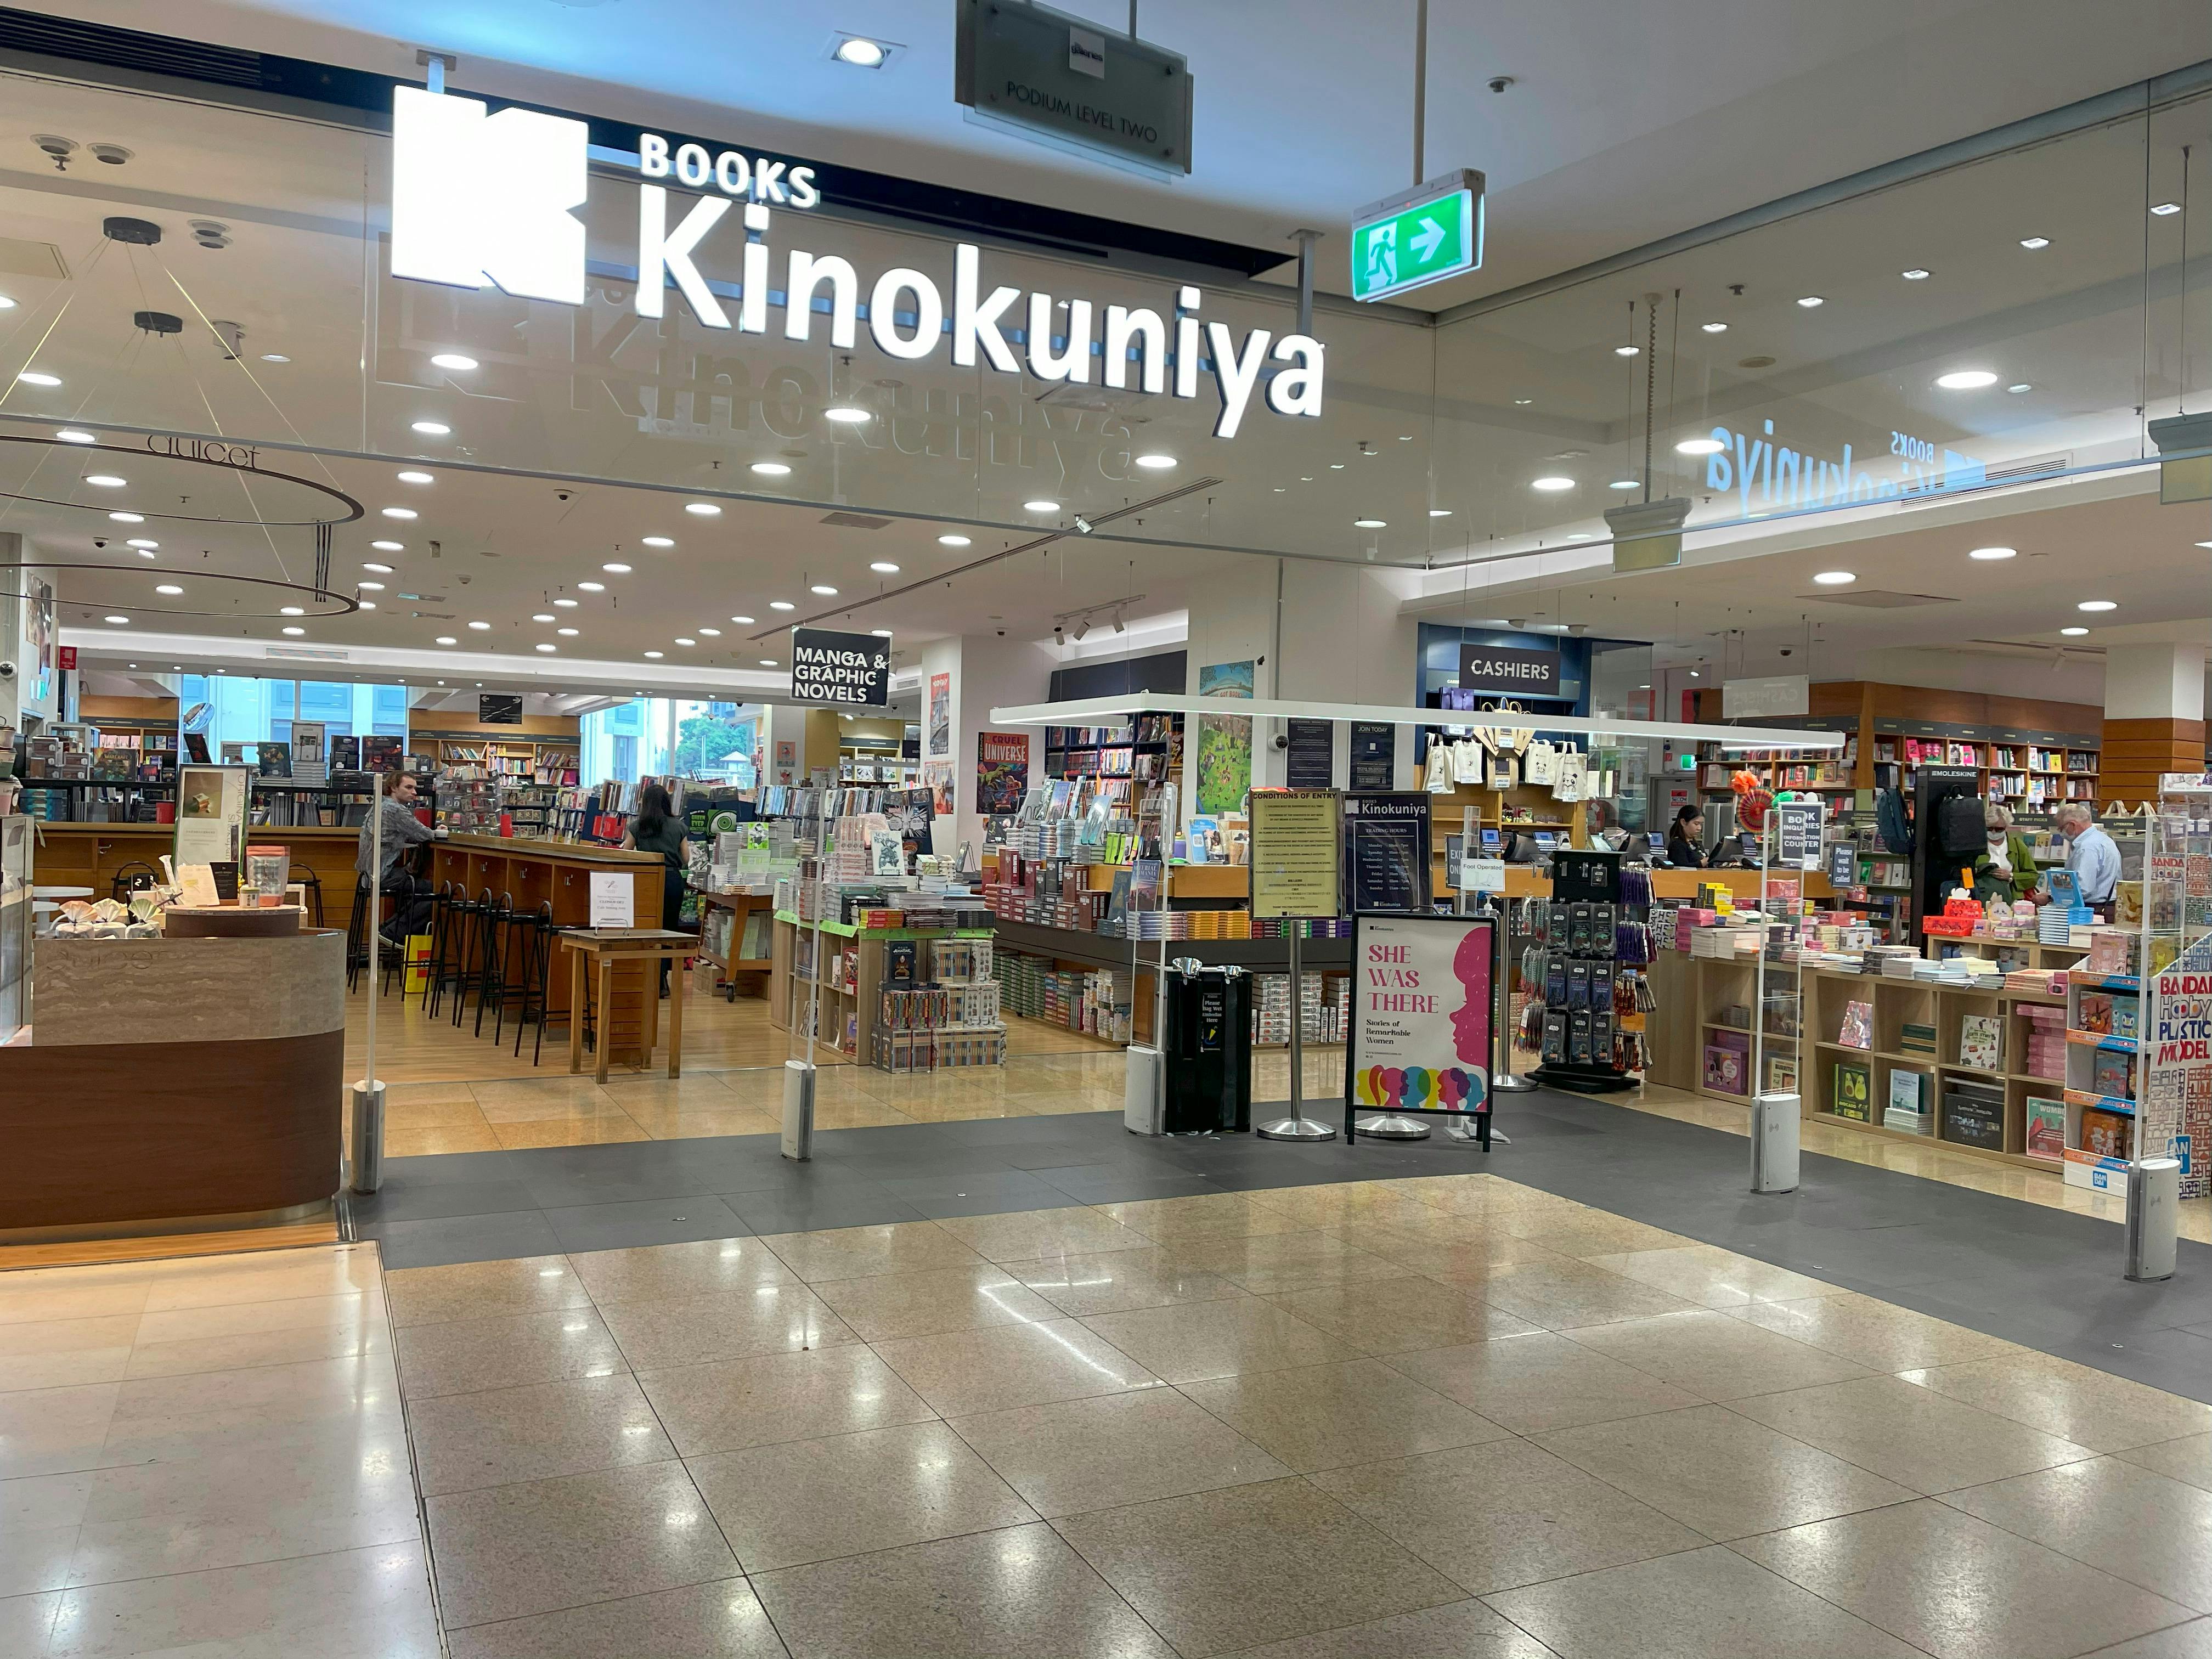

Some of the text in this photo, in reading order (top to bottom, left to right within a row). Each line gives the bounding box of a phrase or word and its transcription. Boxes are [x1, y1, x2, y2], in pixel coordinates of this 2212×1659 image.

[1007, 80, 1158, 143] PODIUM LEVEL TWO
[640, 132, 817, 210] BOOKS
[636, 184, 1327, 438] Kinokuniya
[795, 646, 887, 670] MANGA &
[794, 664, 877, 687] GRAPHIC
[1471, 659, 1550, 680] CASHIERS
[794, 681, 867, 703] NOVELS
[992, 736, 1022, 744] CRUEL
[985, 743, 1026, 761] UNIVERSE
[1362, 803, 1426, 817] Kinokuniya
[1783, 822, 1820, 831] INQURIES
[1450, 849, 1463, 860] EXIT
[1836, 847, 1853, 855] Please
[1368, 944, 1412, 964] SHE
[1368, 968, 1420, 988] WAS
[1367, 992, 1439, 1014] THERE
[1366, 1028, 1411, 1037] Remarkable
[1366, 1036, 1394, 1045] Women
[2040, 1105, 2065, 1115] WOMB
[2094, 1172, 2107, 1181] BAN
